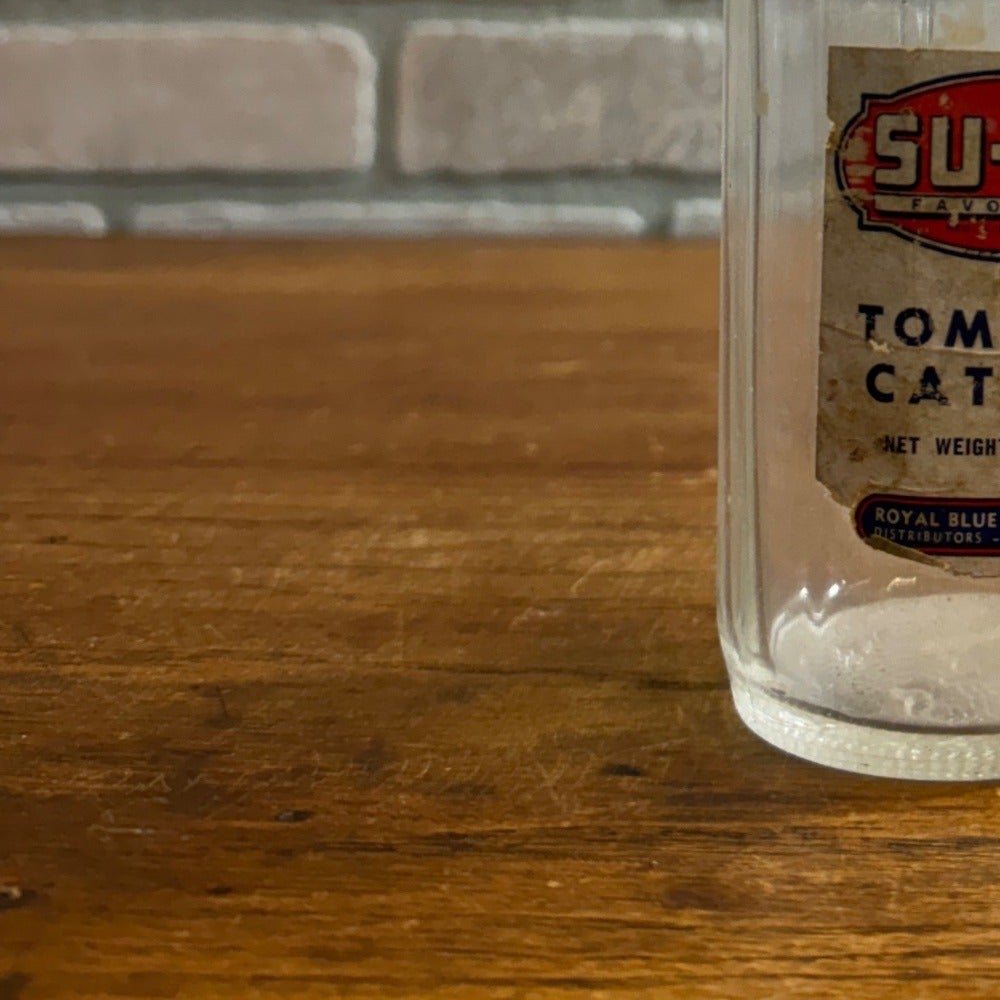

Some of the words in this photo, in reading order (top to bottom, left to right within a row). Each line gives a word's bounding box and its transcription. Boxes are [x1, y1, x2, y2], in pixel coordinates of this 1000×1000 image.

[883, 435, 921, 455] NET
[874, 507, 940, 528] ROYAL
[948, 510, 997, 529] BLUE
